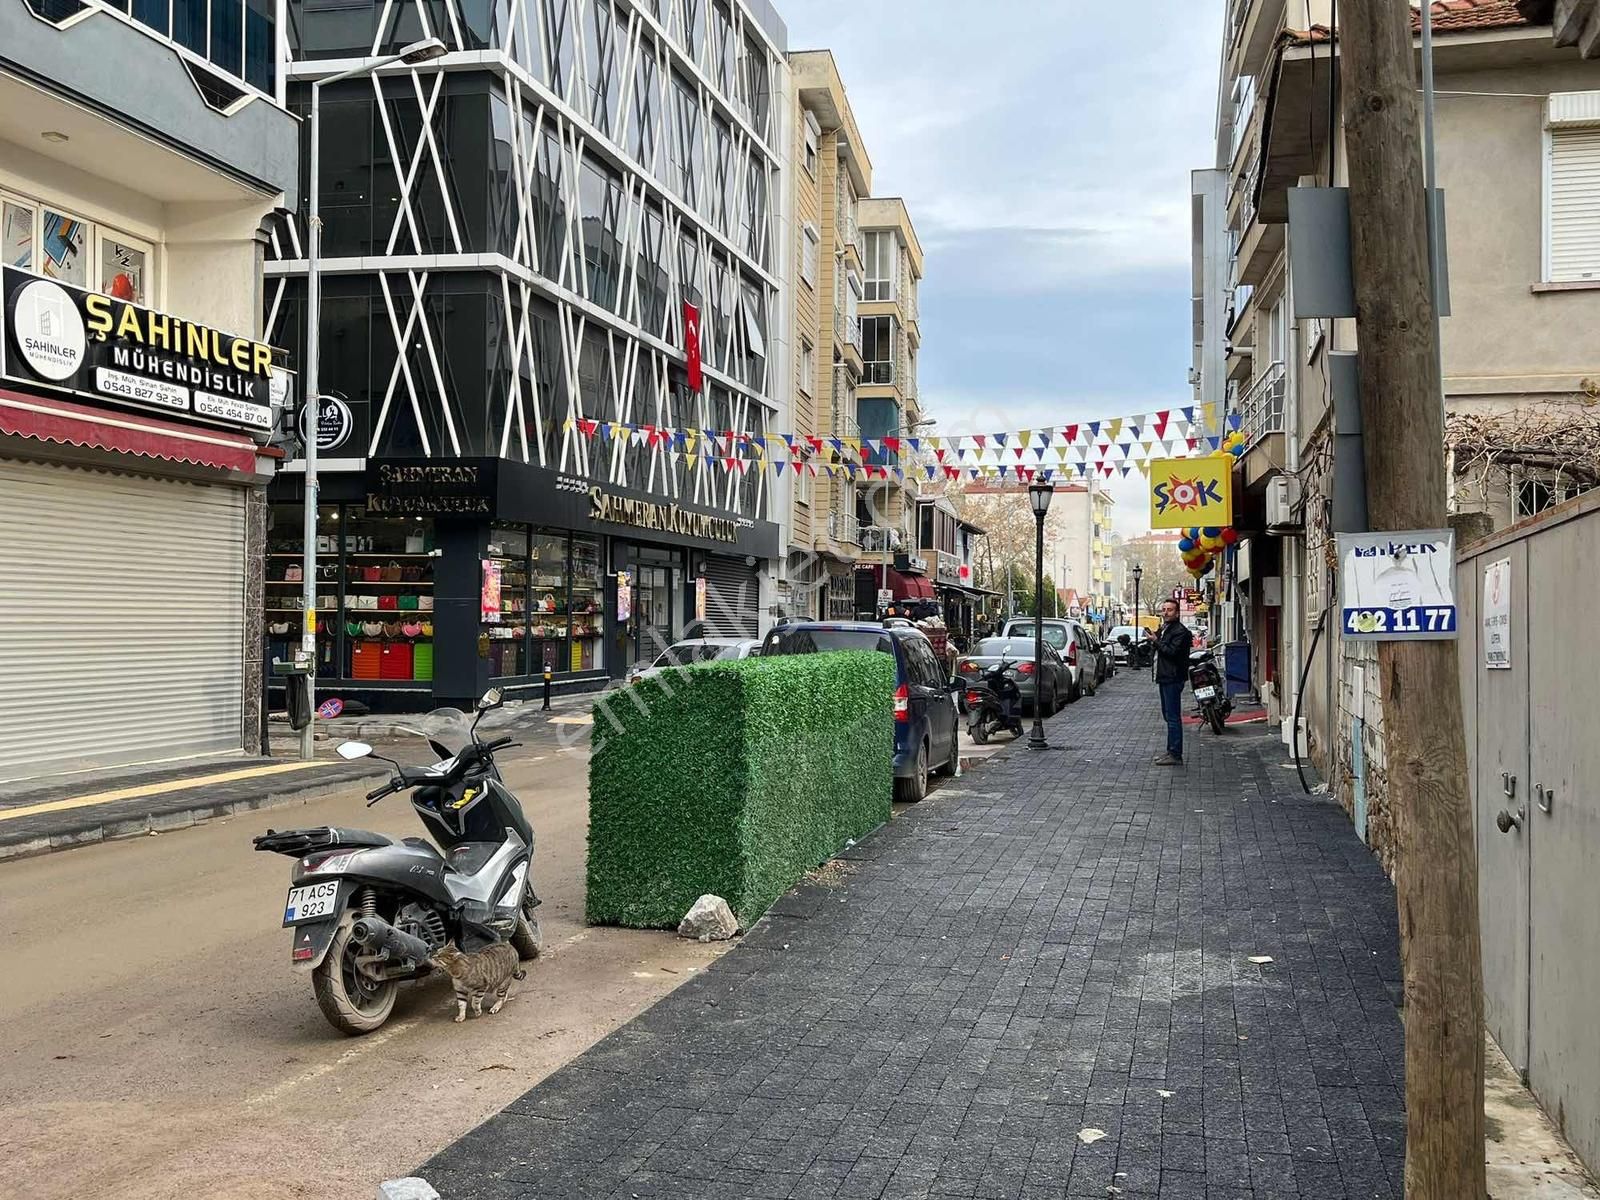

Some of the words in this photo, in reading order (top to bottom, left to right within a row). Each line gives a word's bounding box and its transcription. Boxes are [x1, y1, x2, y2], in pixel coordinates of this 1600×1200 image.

[114, 346, 255, 398] MÜHENDİSLİK
[103, 380, 132, 395] 0543
[135, 387, 153, 399] 827
[156, 392, 169, 403] 92
[171, 395, 183, 406] 29
[200, 402, 224, 415] 0545
[226, 408, 242, 419] 454
[244, 412, 255, 422] 87
[256, 414, 268, 425] 04
[1153, 478, 1223, 515] ŞOK
[1347, 610, 1387, 633] 42
[1393, 609, 1420, 631] 11
[1425, 608, 1451, 631] 77
[290, 888, 306, 904] 71
[308, 883, 336, 900] ACS
[301, 901, 325, 917] 923
